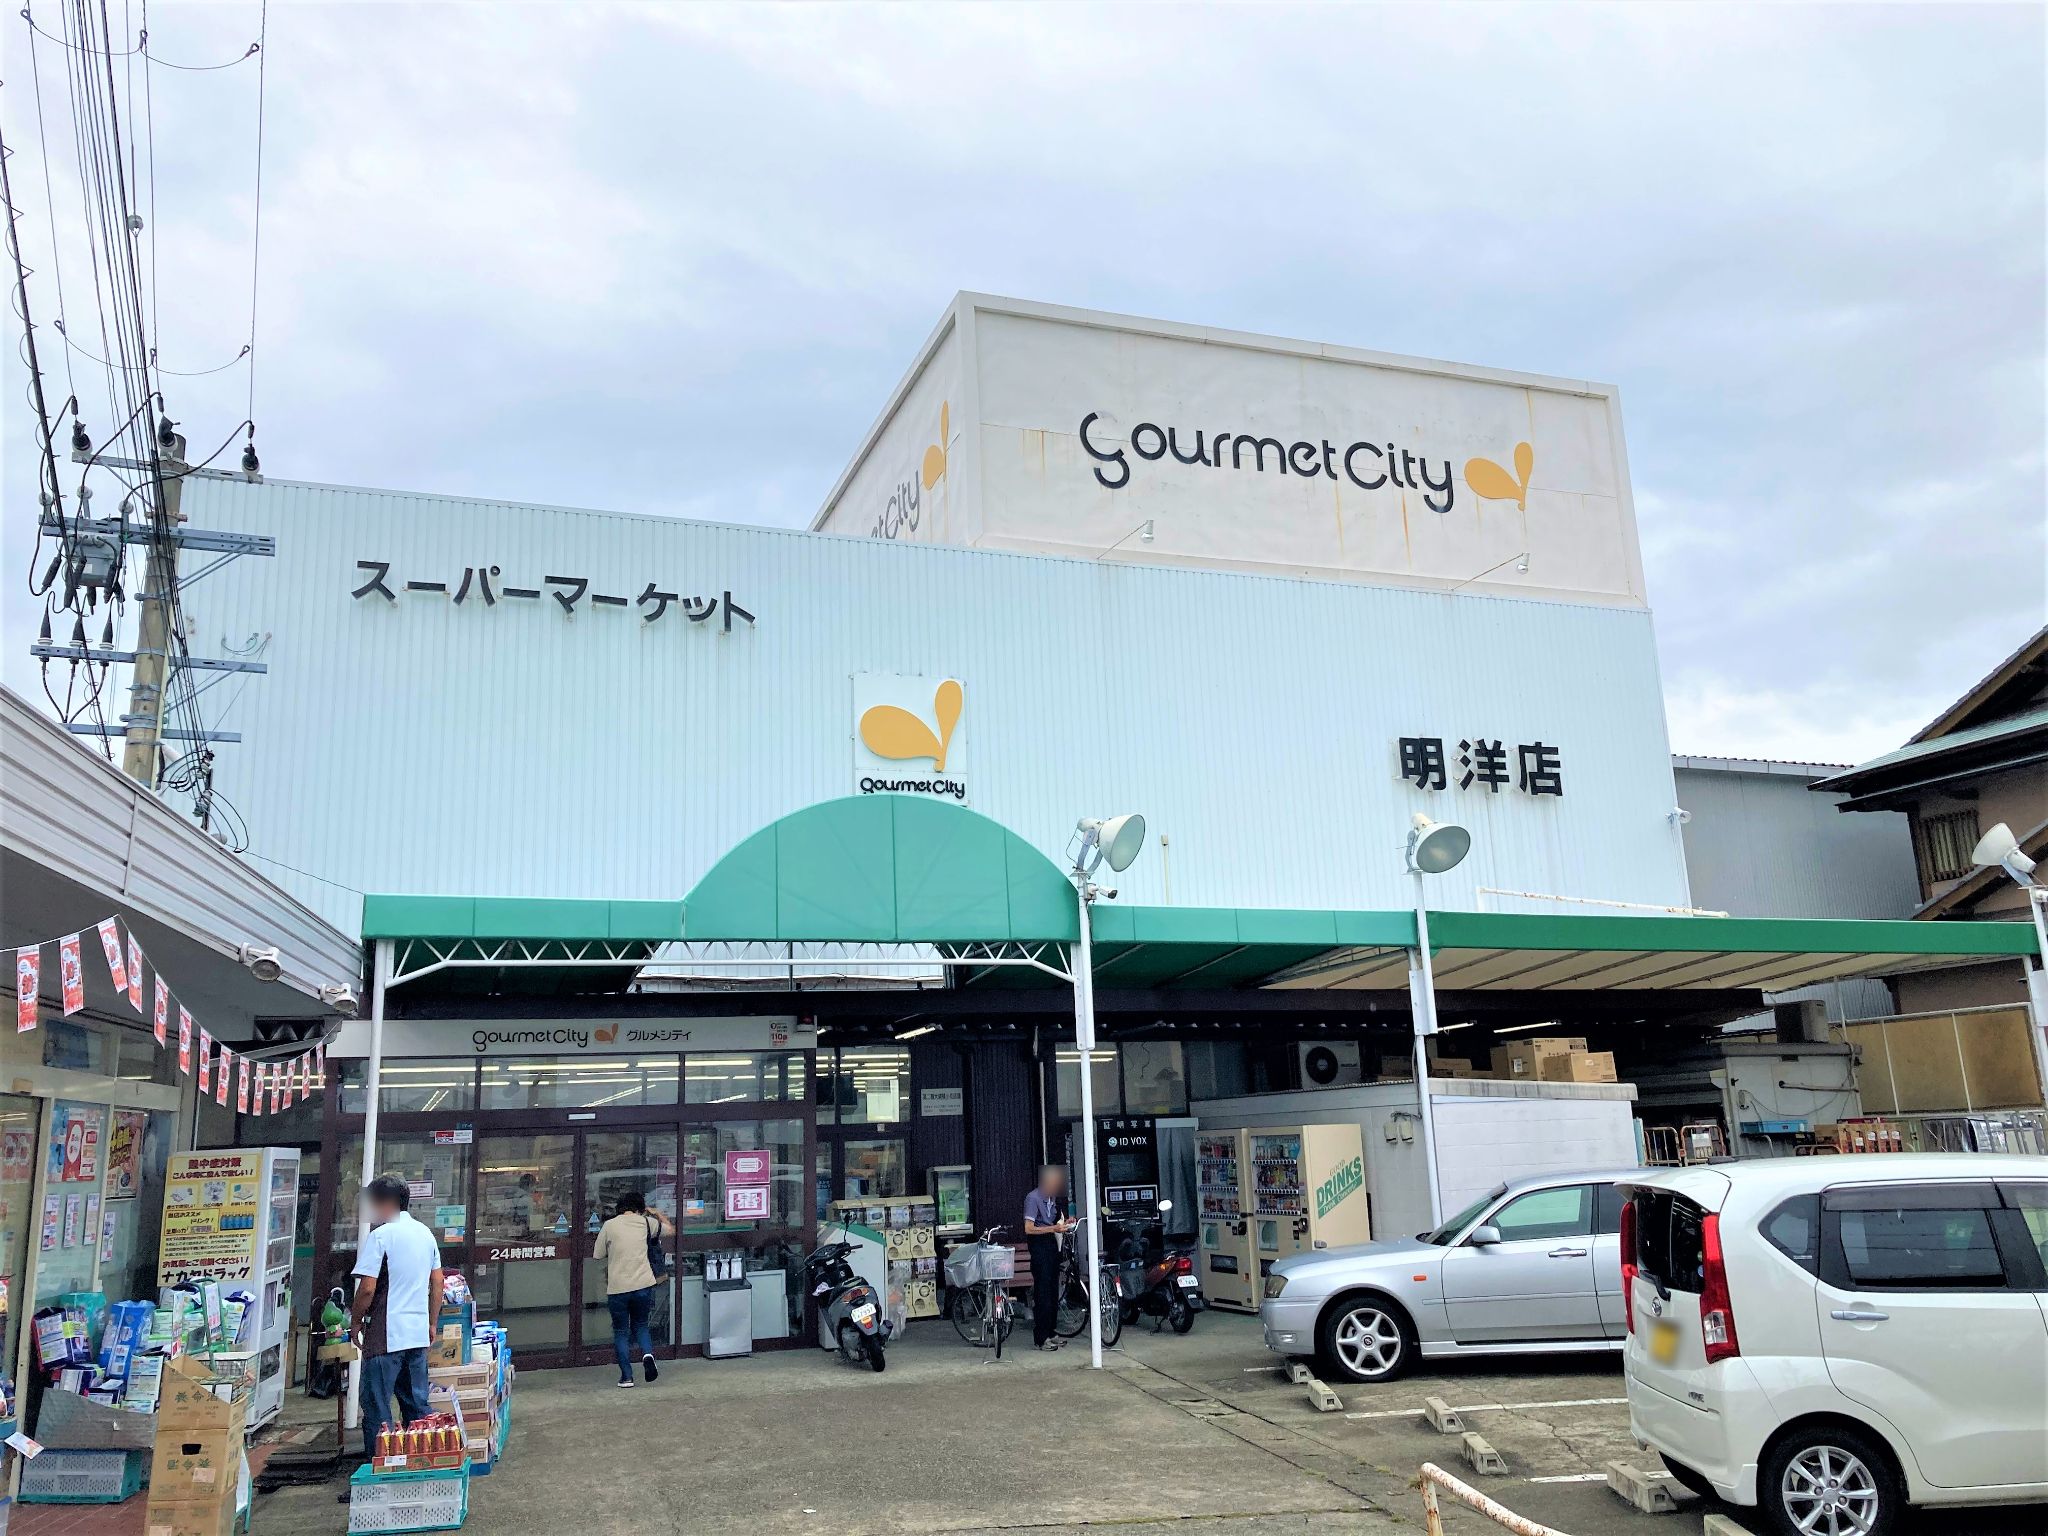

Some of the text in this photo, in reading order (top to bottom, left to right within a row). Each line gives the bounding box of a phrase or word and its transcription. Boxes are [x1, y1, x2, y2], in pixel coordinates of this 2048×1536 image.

[351, 560, 755, 632] スーパーマーケット
[1399, 738, 1562, 796] 明洋店
[627, 1029, 691, 1041] グルメシティ
[1119, 1136, 1147, 1146] ID VOX
[188, 1157, 242, 1169] 熱中症対策
[1316, 1156, 1362, 1209] DRINKS
[490, 1245, 556, 1260] 24時間営業
